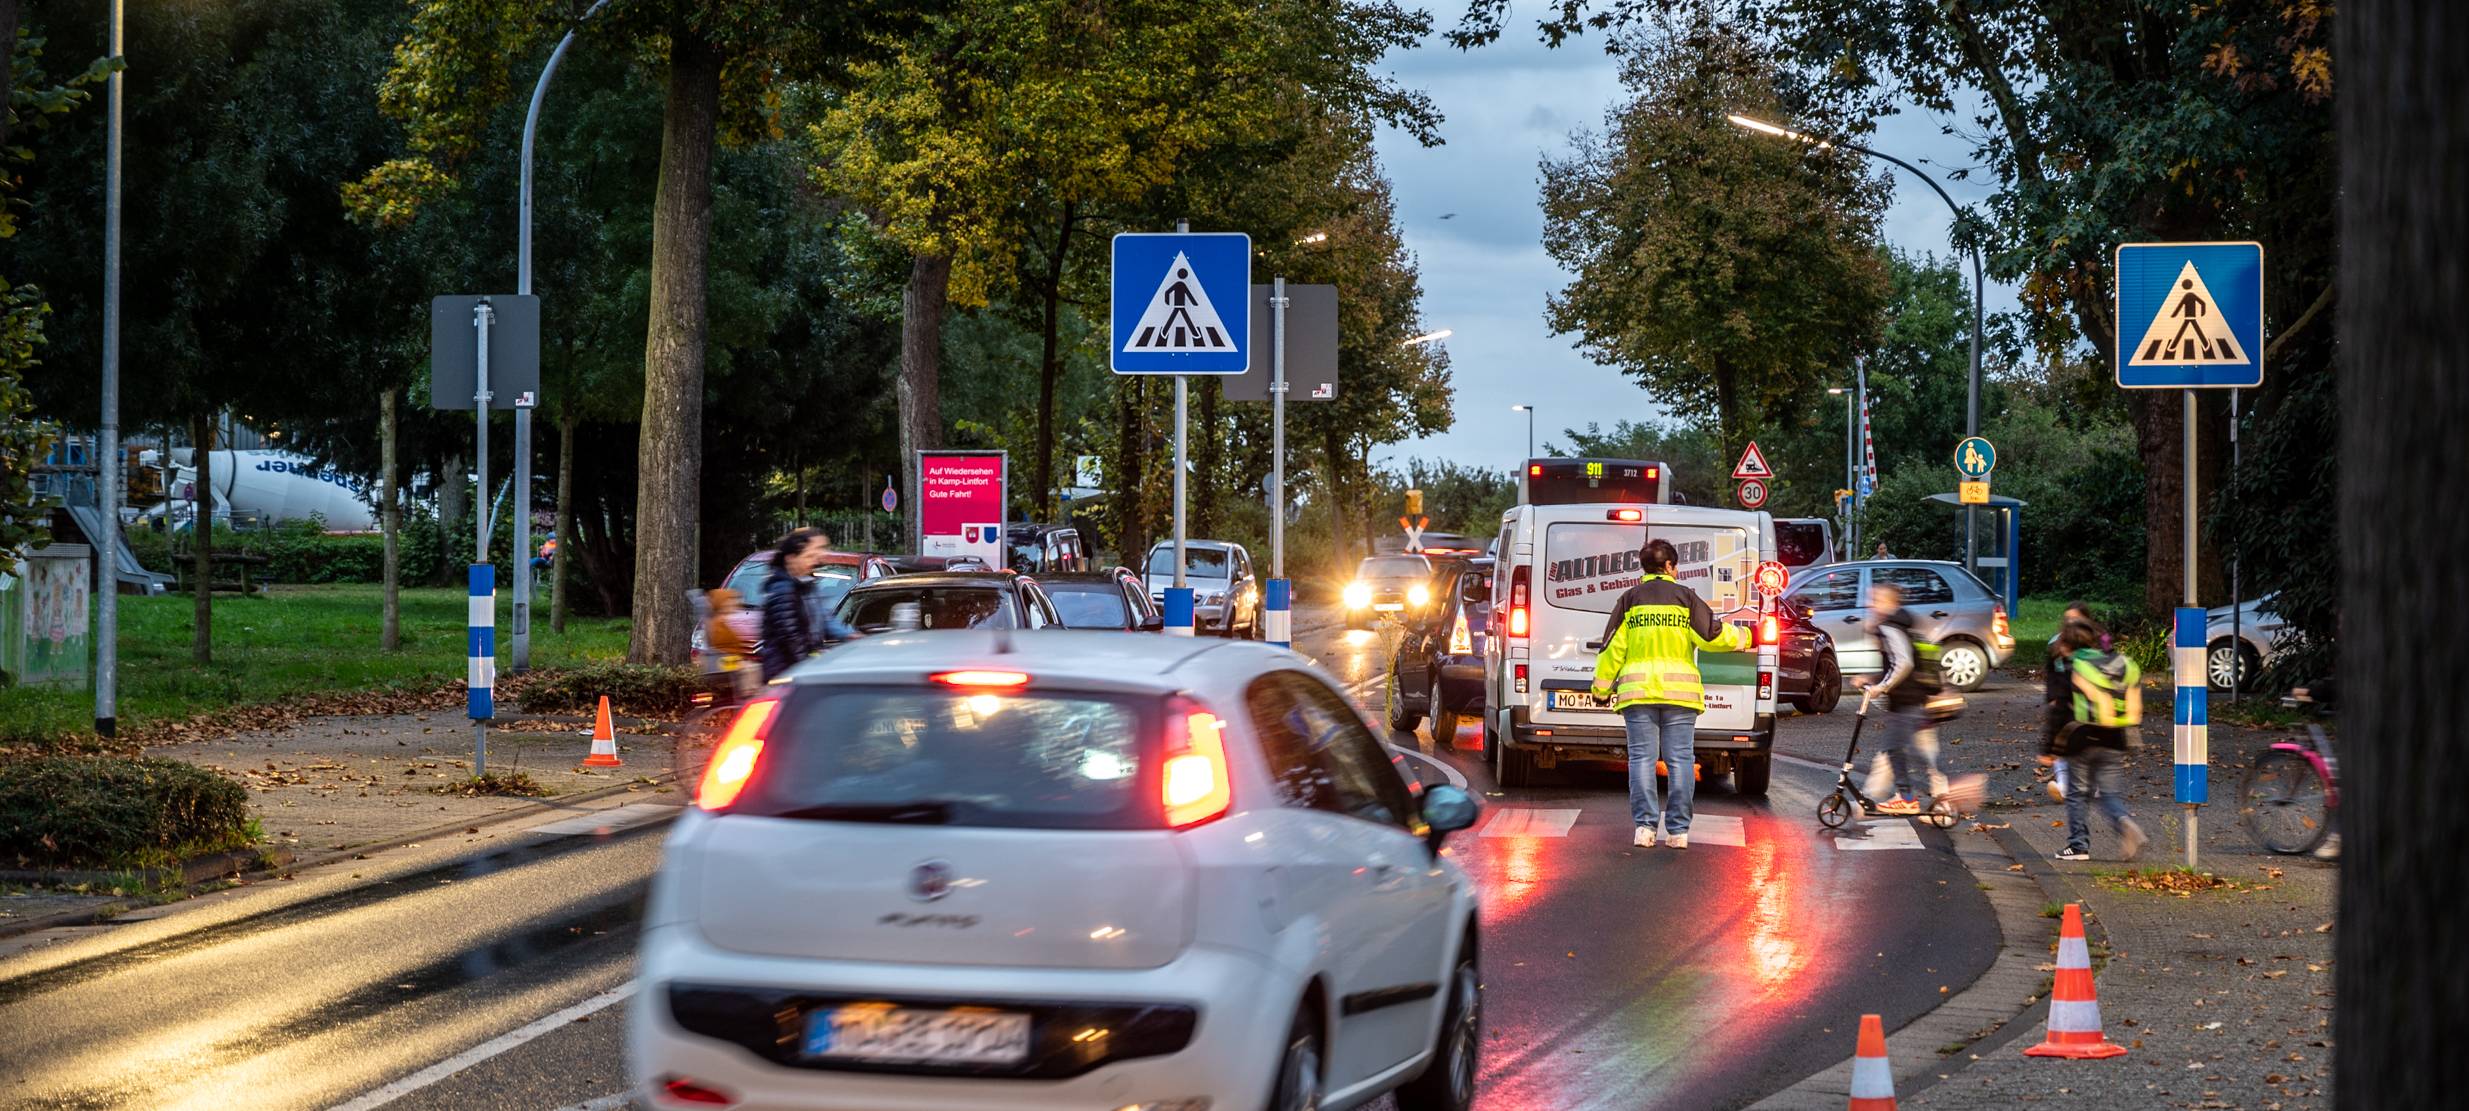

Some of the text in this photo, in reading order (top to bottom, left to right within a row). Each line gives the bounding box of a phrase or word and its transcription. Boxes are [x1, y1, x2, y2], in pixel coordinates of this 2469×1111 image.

[929, 467, 993, 475] Auf Wiedersehen
[1587, 463, 1602, 475] 911
[1624, 469, 1638, 477] 3712
[938, 478, 988, 487] Kamp-Lintfort
[929, 490, 972, 498] Gute Fahrt!
[1744, 486, 1761, 499] 30
[1555, 540, 1709, 583] ALTLECER
[1555, 586, 1583, 599] Glas
[1586, 583, 1596, 593] &
[1559, 694, 1576, 707] MO
